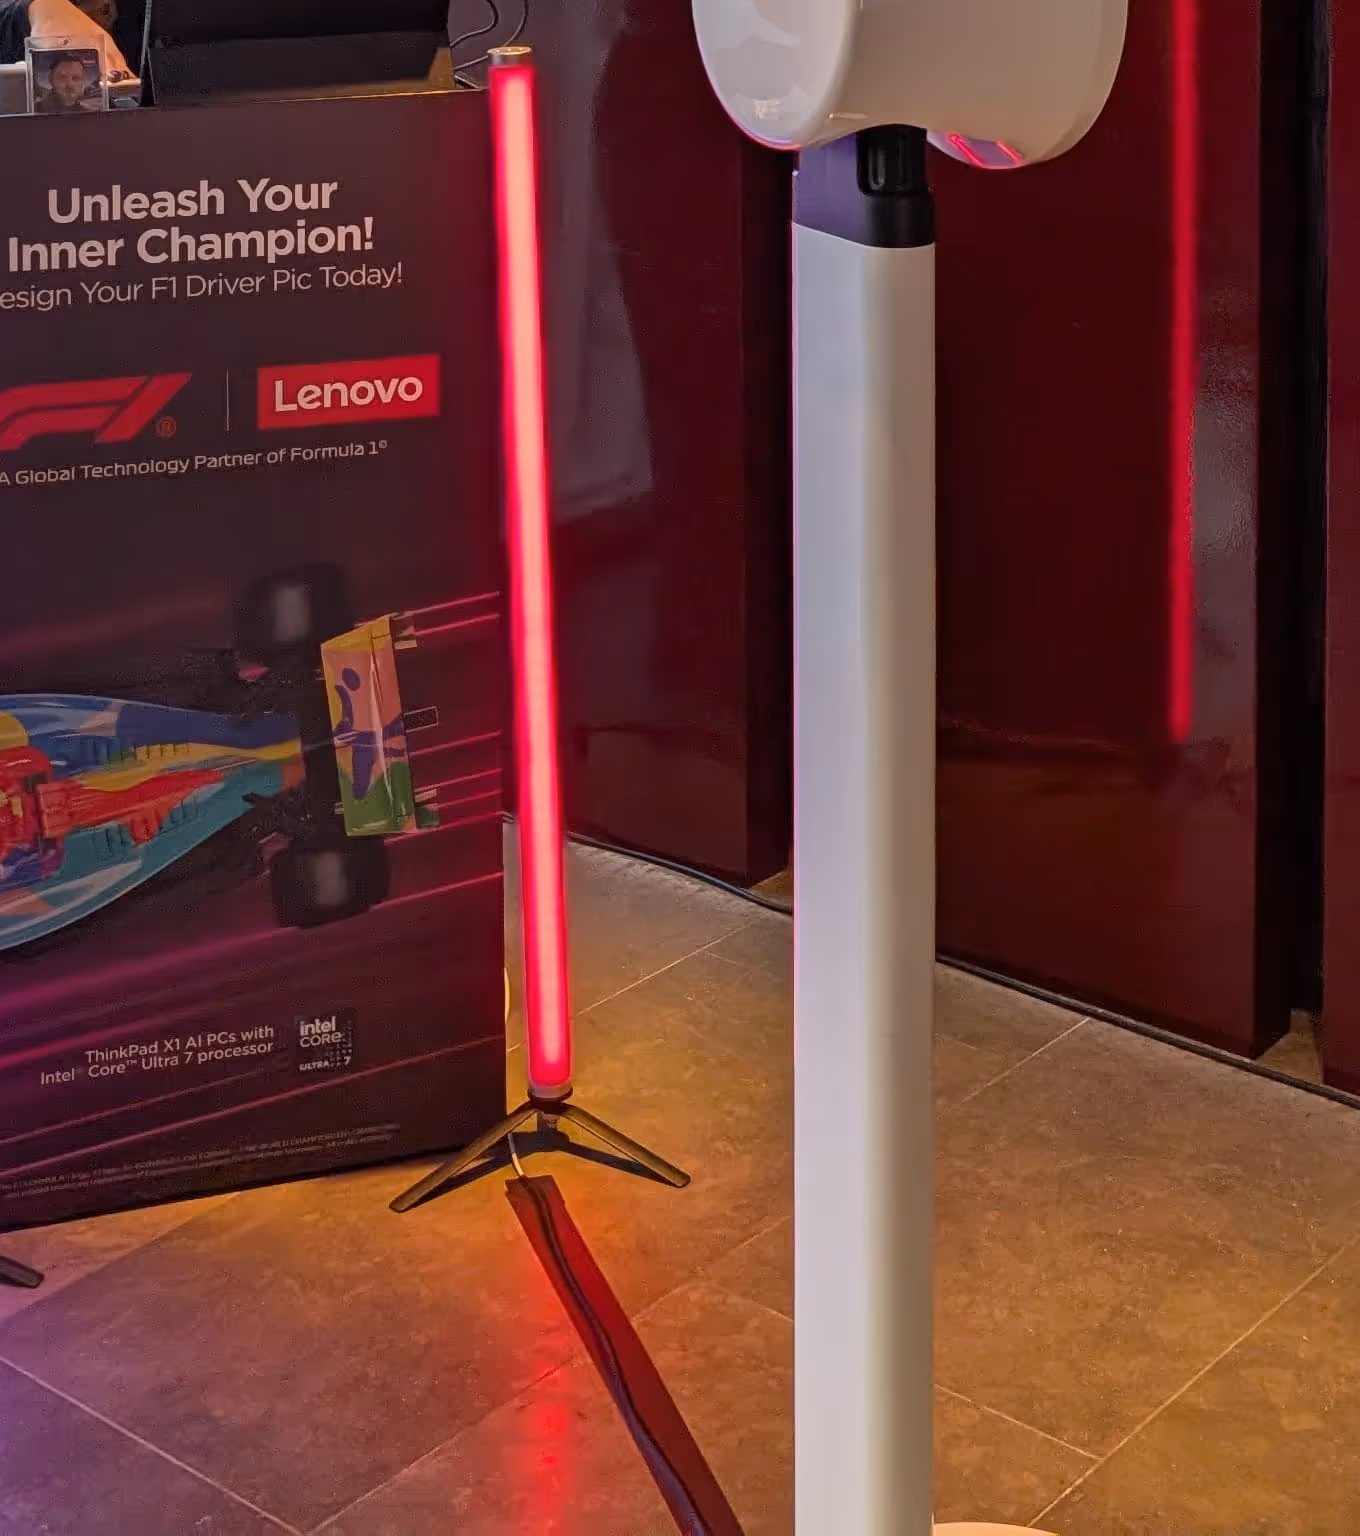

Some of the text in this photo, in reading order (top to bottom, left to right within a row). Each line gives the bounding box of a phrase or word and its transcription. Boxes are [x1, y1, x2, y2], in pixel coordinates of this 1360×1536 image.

[48, 177, 339, 224] Unleash Your
[8, 216, 374, 273] Inner Champion!
[80, 280, 143, 304] Your
[151, 276, 177, 300] F1
[186, 272, 266, 298] Driver
[273, 268, 313, 293] Pic
[318, 262, 404, 289] Today!
[274, 376, 423, 413] Lenovo
[15, 467, 76, 485] Global
[80, 457, 190, 480] Technology
[194, 452, 262, 470] Partner
[266, 448, 287, 464] of
[290, 443, 365, 462] Formula
[85, 1025, 275, 1064] ThinkPad X1 AI PCs with
[299, 1015, 337, 1037] intel
[141, 1055, 180, 1071] Ultra
[184, 1051, 194, 1065] 7
[197, 1041, 275, 1066] processor
